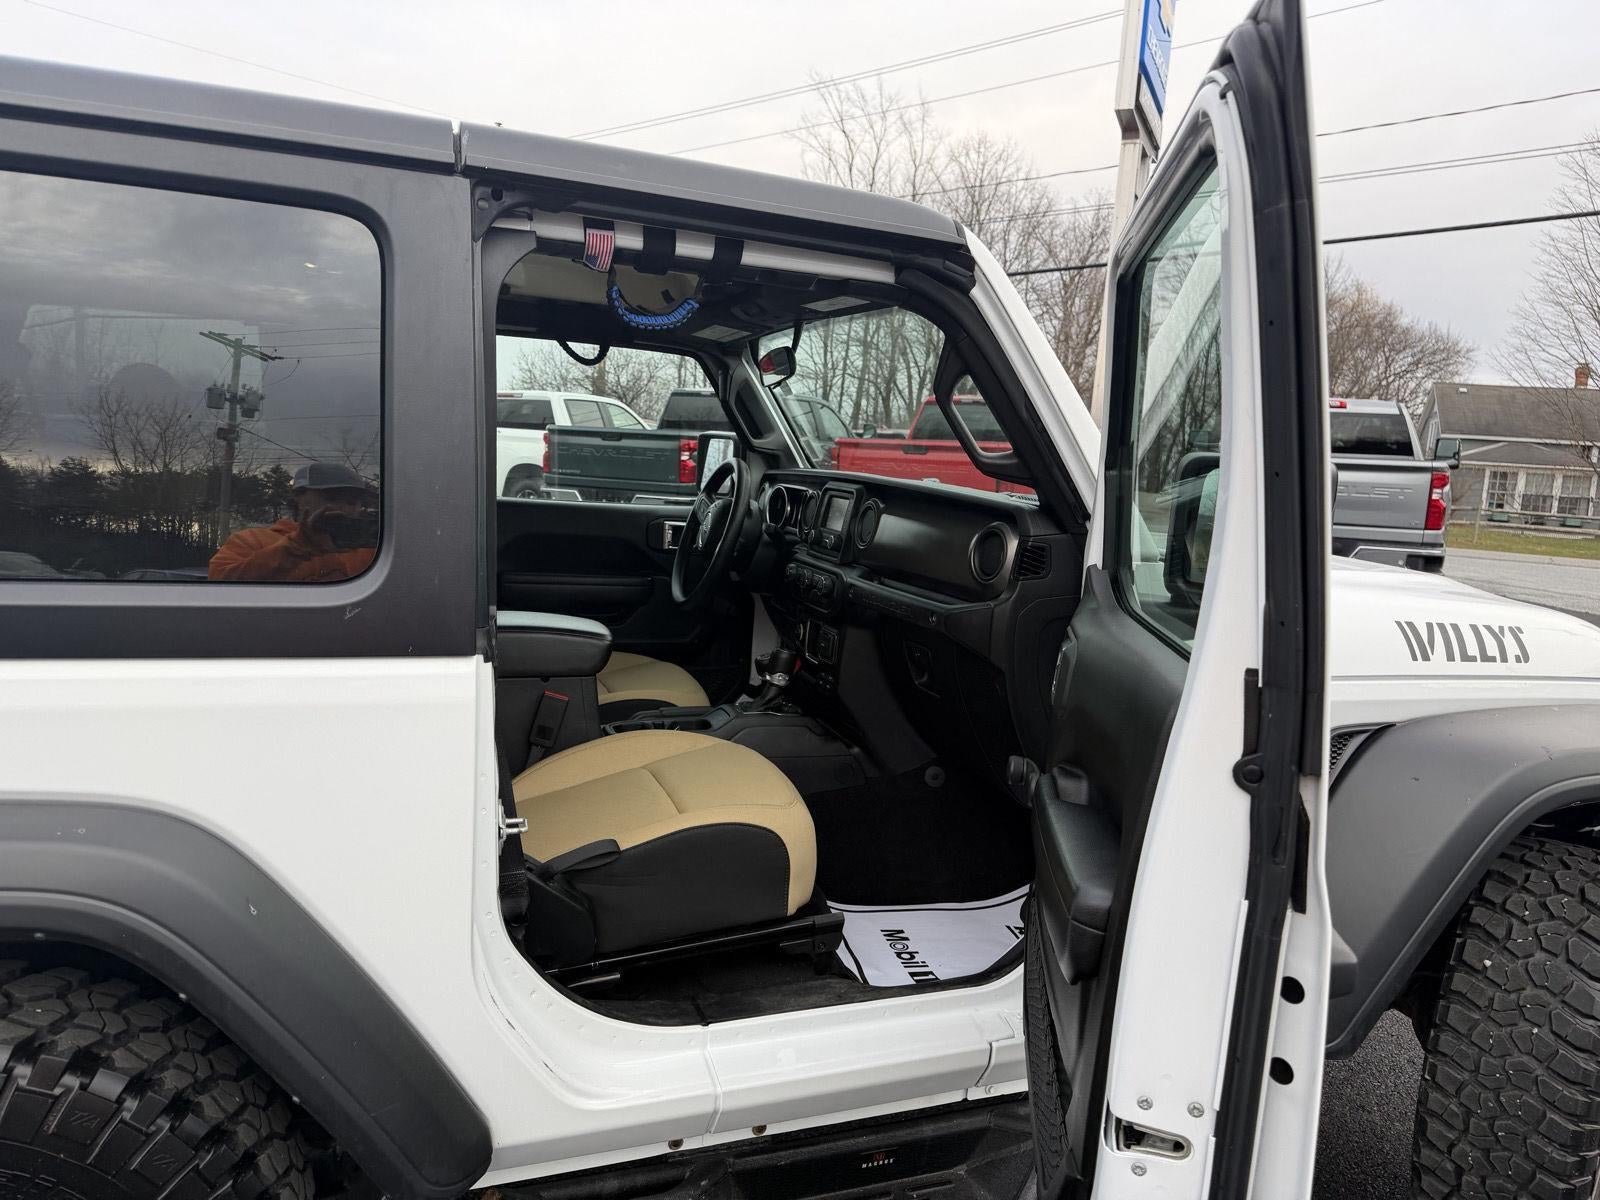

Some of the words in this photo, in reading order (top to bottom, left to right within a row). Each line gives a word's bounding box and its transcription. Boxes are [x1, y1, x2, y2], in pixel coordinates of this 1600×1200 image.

[559, 446, 671, 460] CHEVROLET
[1395, 620, 1530, 663] WILLYS
[880, 929, 929, 968] Mobil
